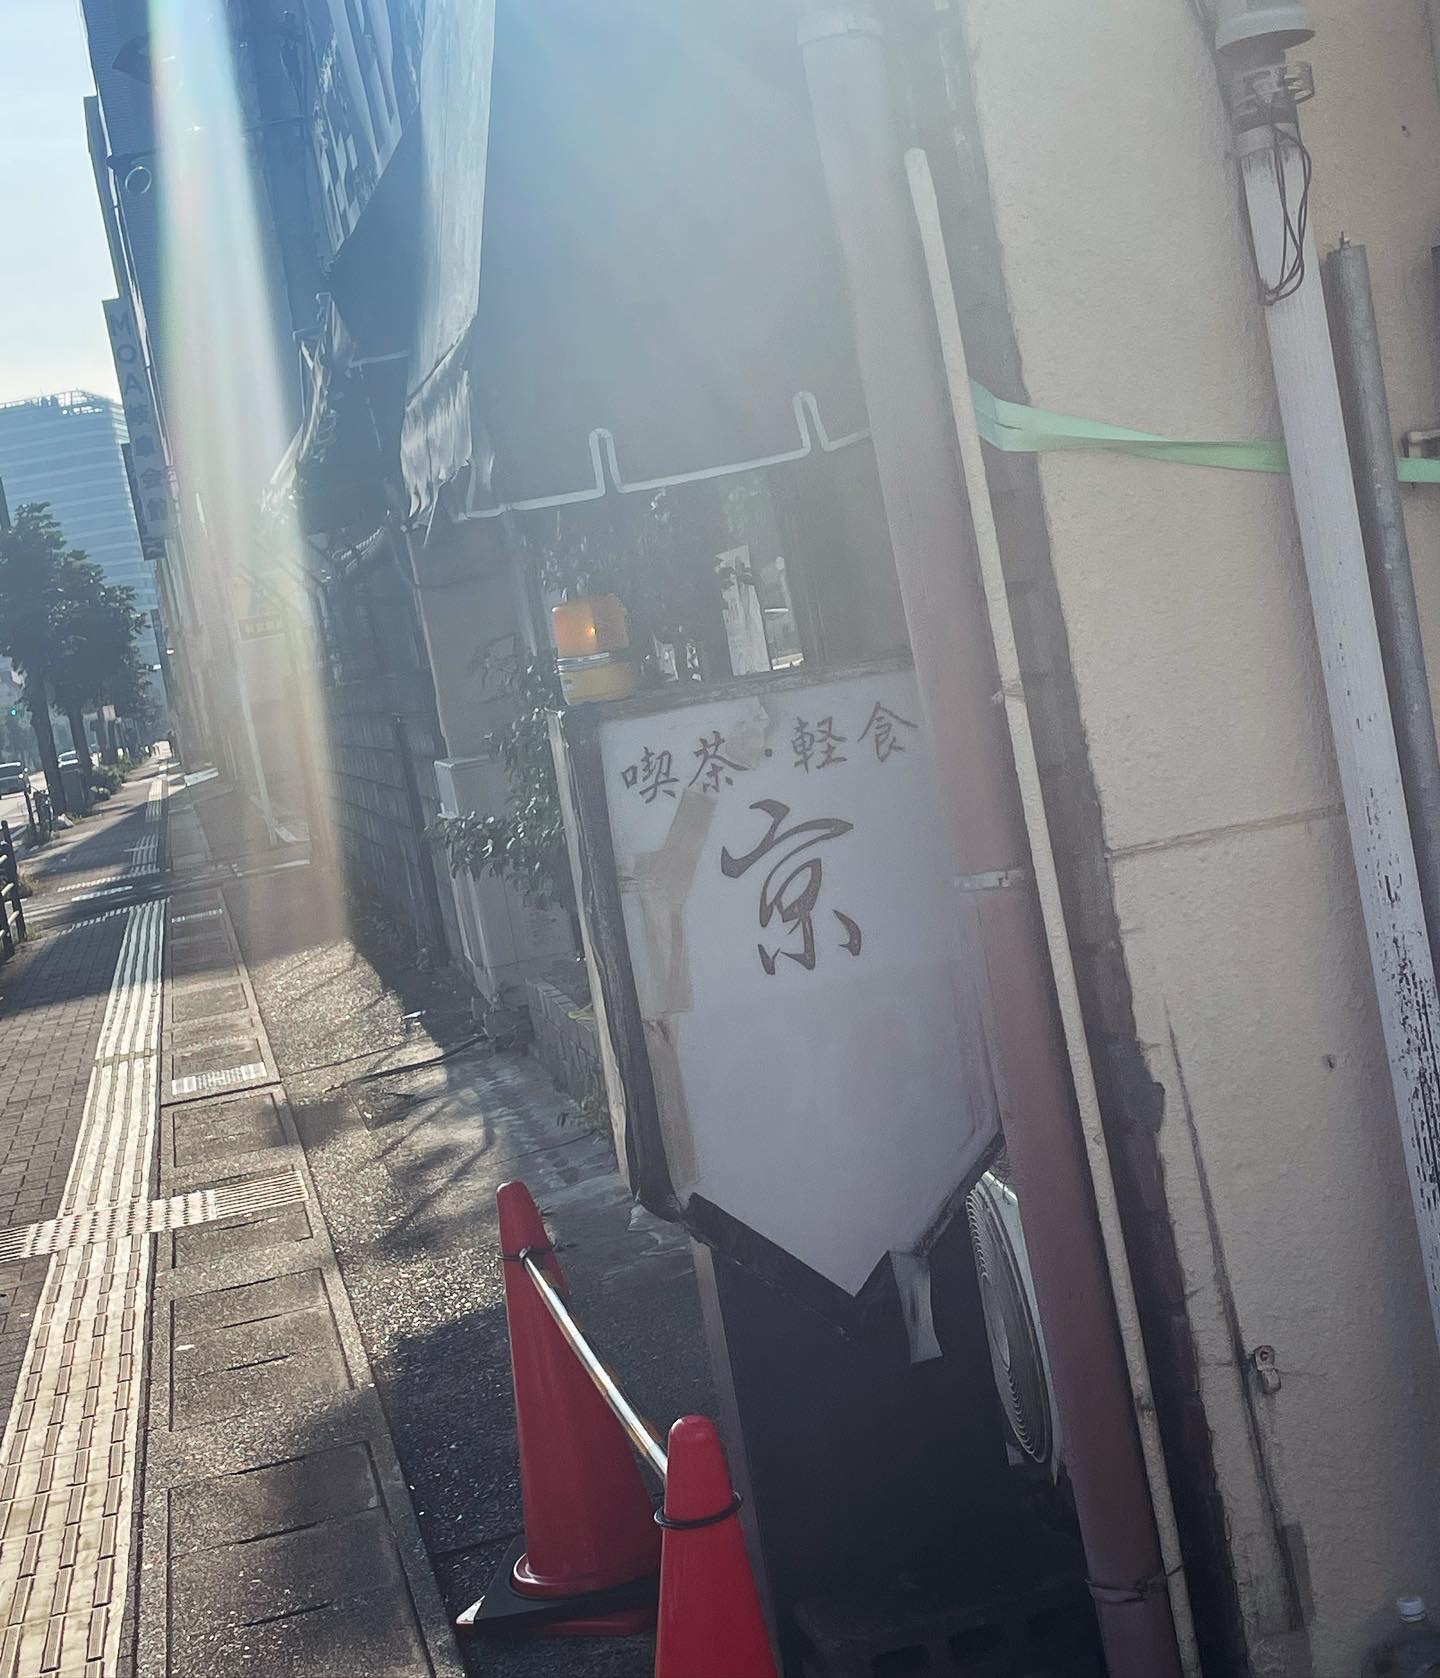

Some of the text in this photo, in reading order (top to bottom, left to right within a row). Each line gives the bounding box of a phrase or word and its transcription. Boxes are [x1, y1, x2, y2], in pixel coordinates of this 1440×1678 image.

[621, 702, 918, 804] 喫茶・軽食
[721, 798, 862, 976] 京
